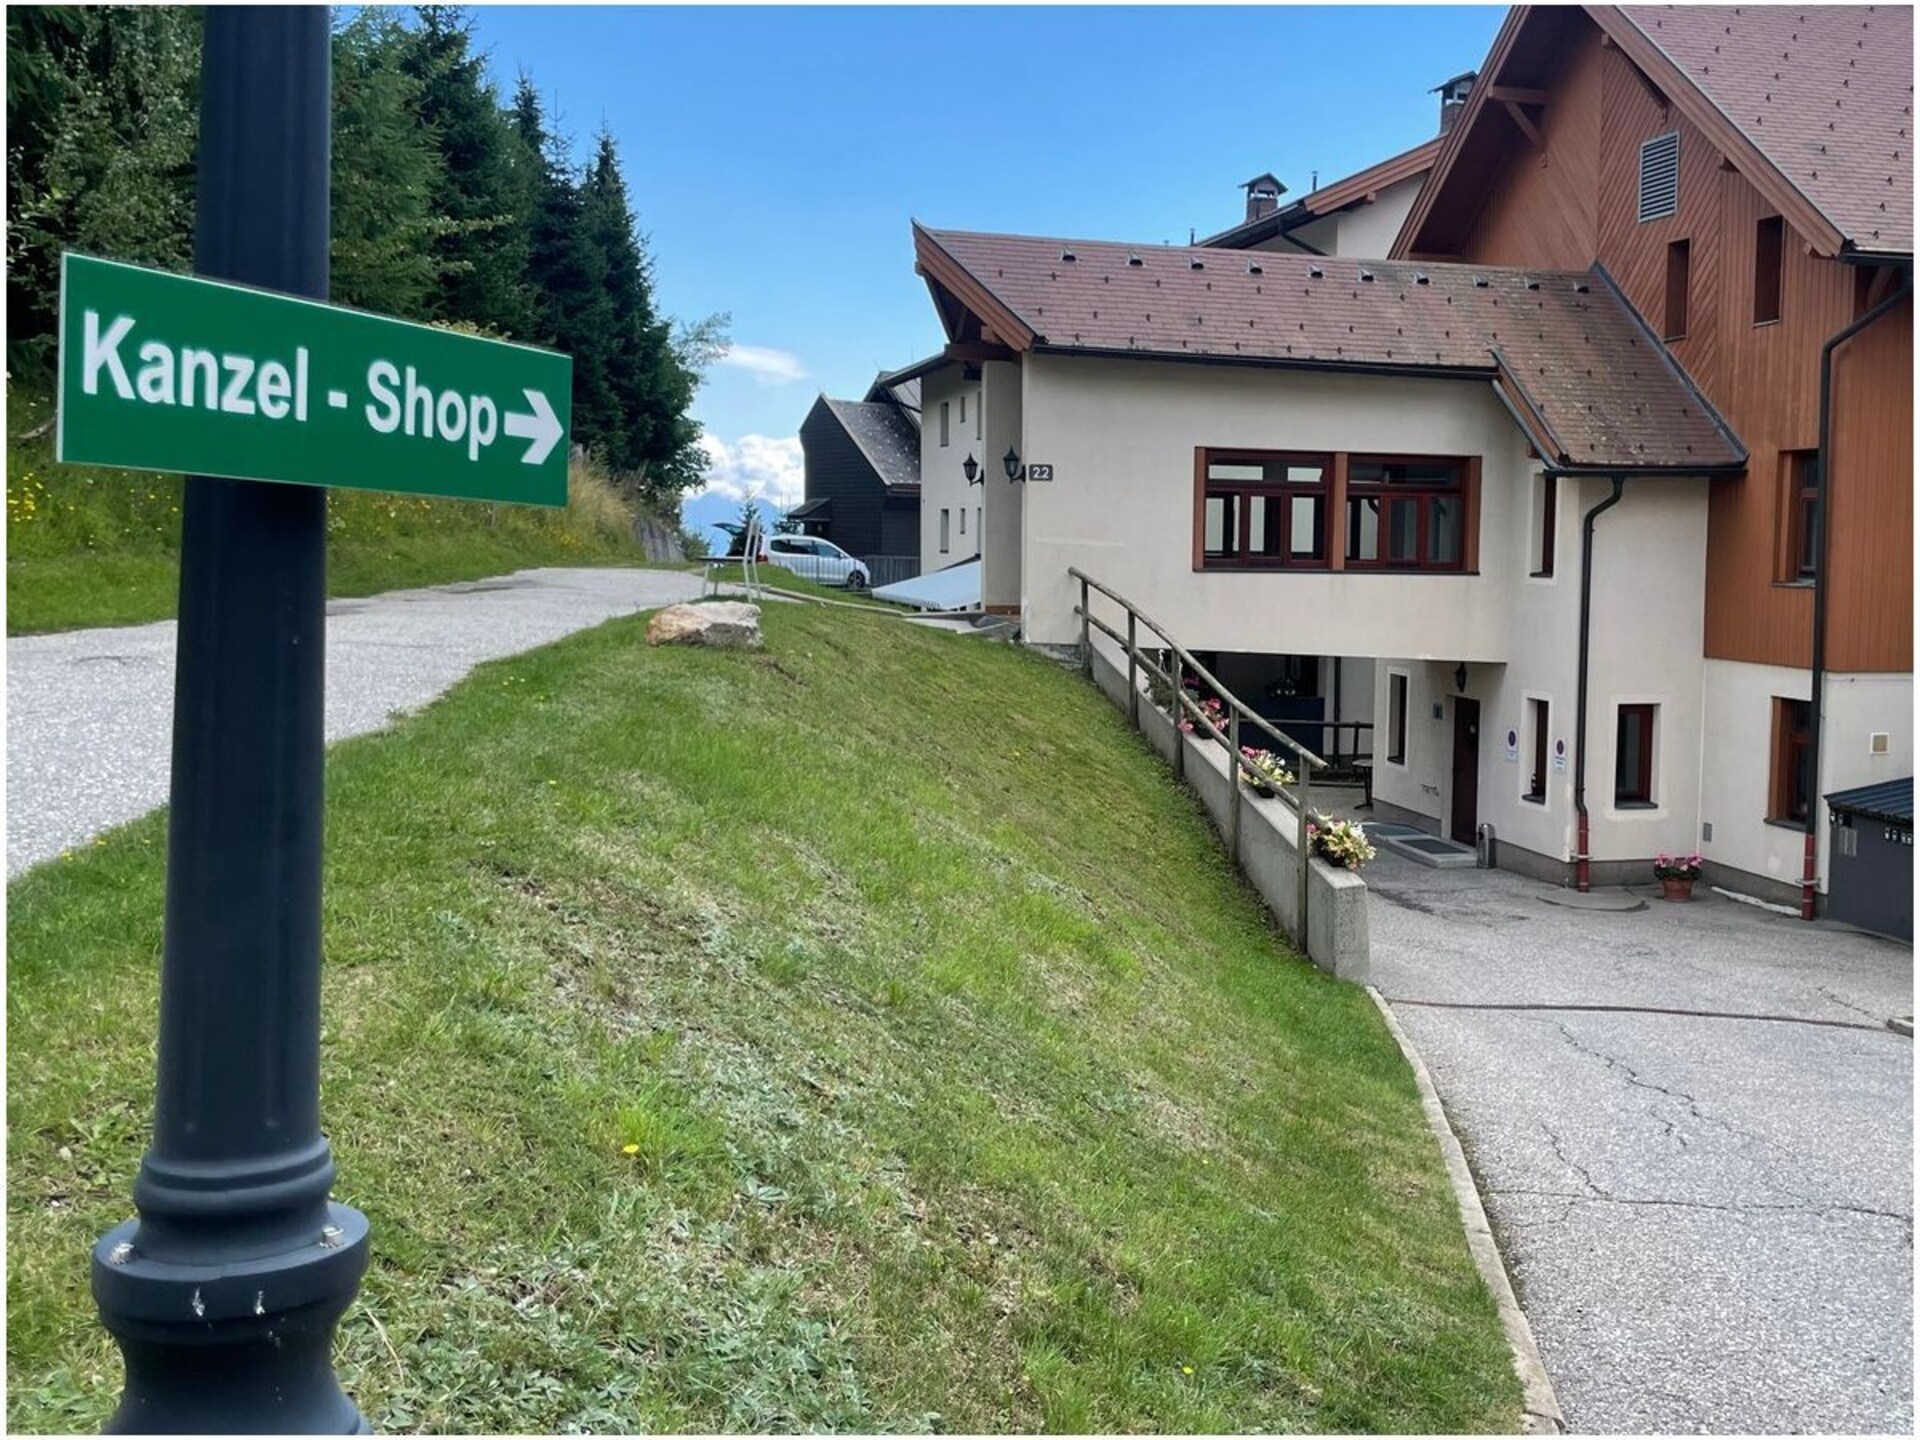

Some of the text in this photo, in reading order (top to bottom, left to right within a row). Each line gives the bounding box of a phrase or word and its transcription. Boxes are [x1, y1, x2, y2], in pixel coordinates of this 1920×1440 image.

[82, 309, 498, 461] Kanzel - Shop
[1032, 466, 1050, 479] 22
